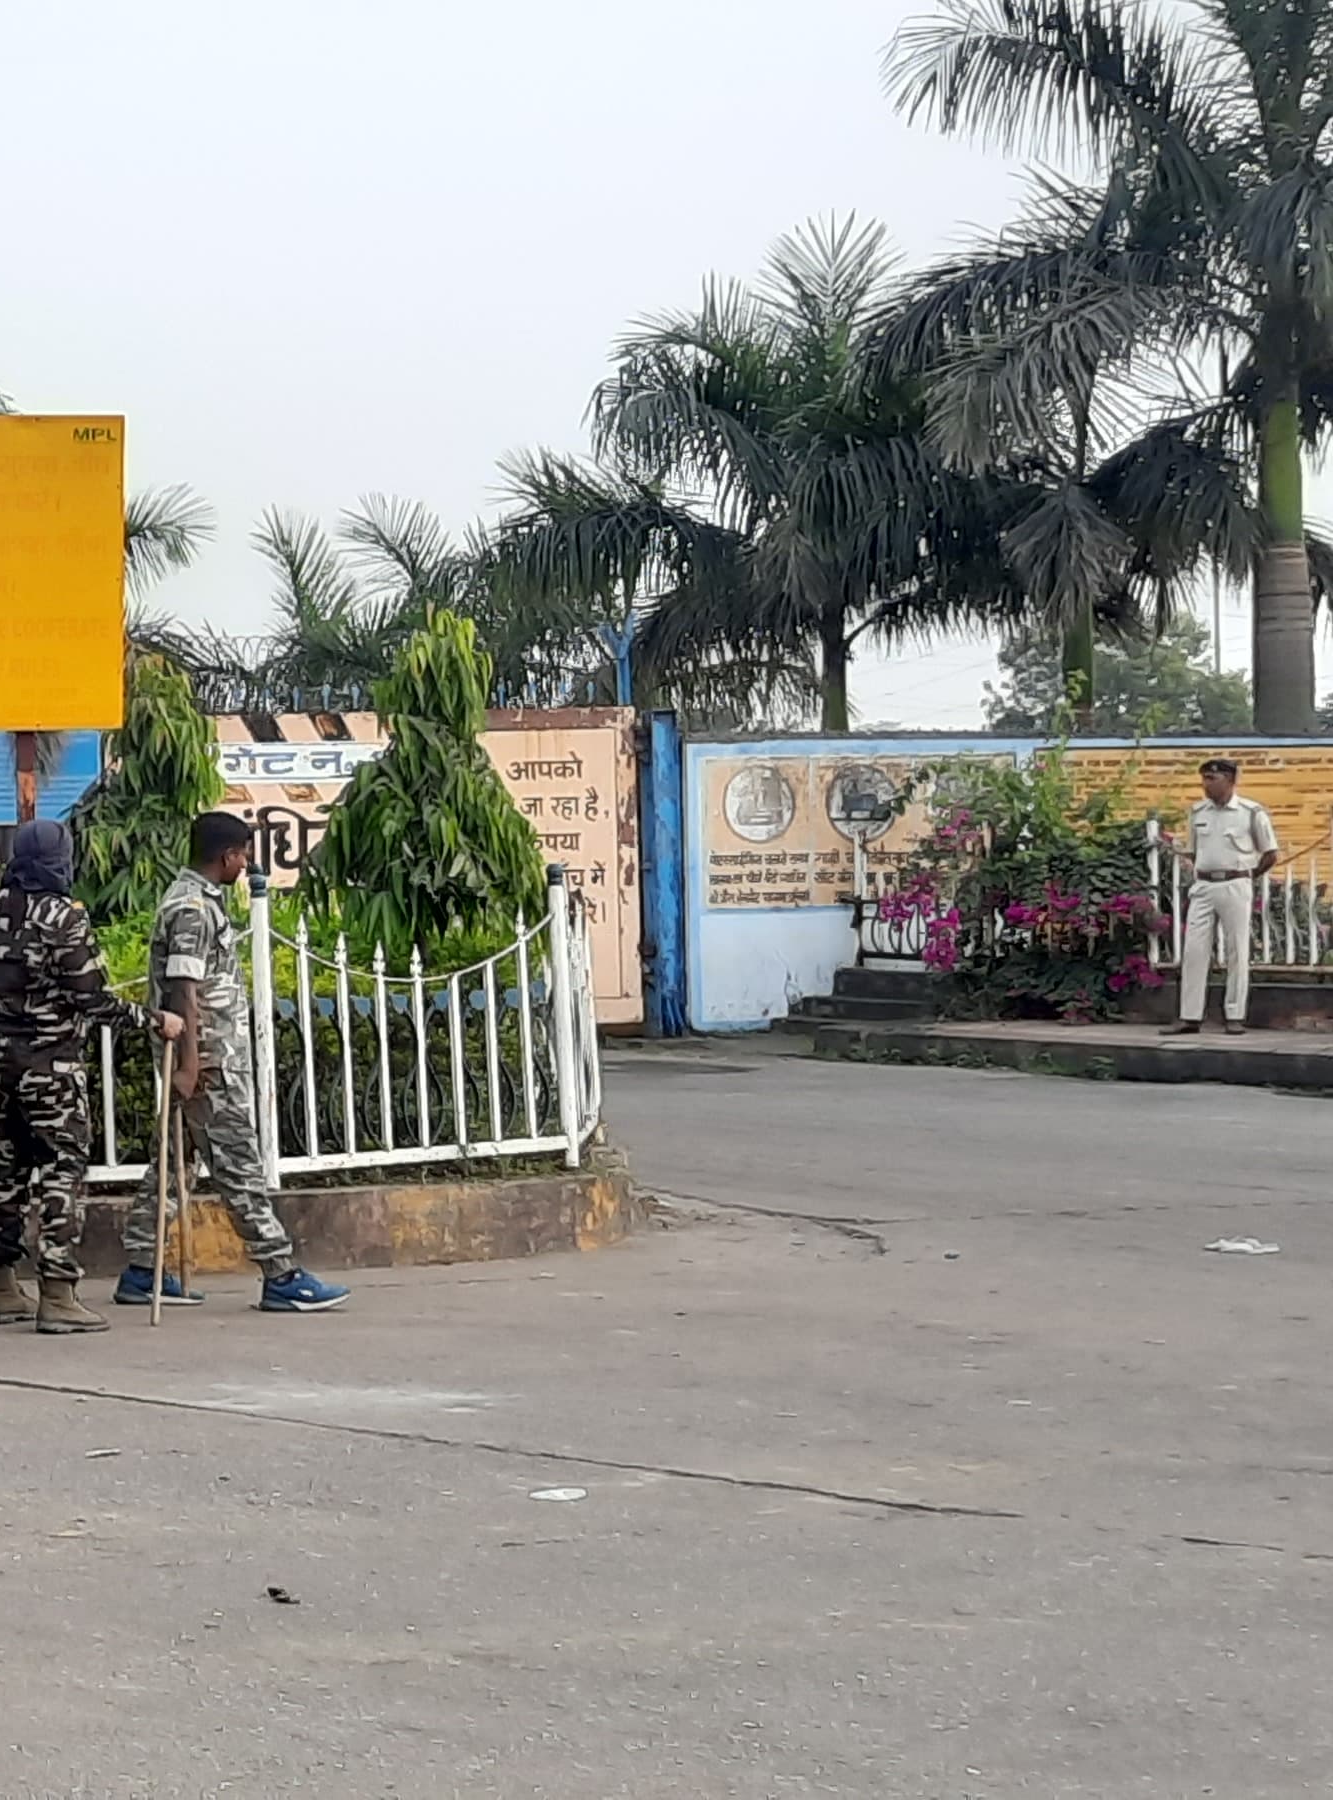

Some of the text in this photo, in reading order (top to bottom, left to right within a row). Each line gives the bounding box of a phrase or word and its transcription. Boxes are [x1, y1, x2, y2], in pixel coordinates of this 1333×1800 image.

[73, 426, 118, 442] MPL
[505, 750, 583, 782] आपको
[520, 796, 544, 818] जा
[550, 796, 580, 820] रहा
[590, 860, 606, 887] में
